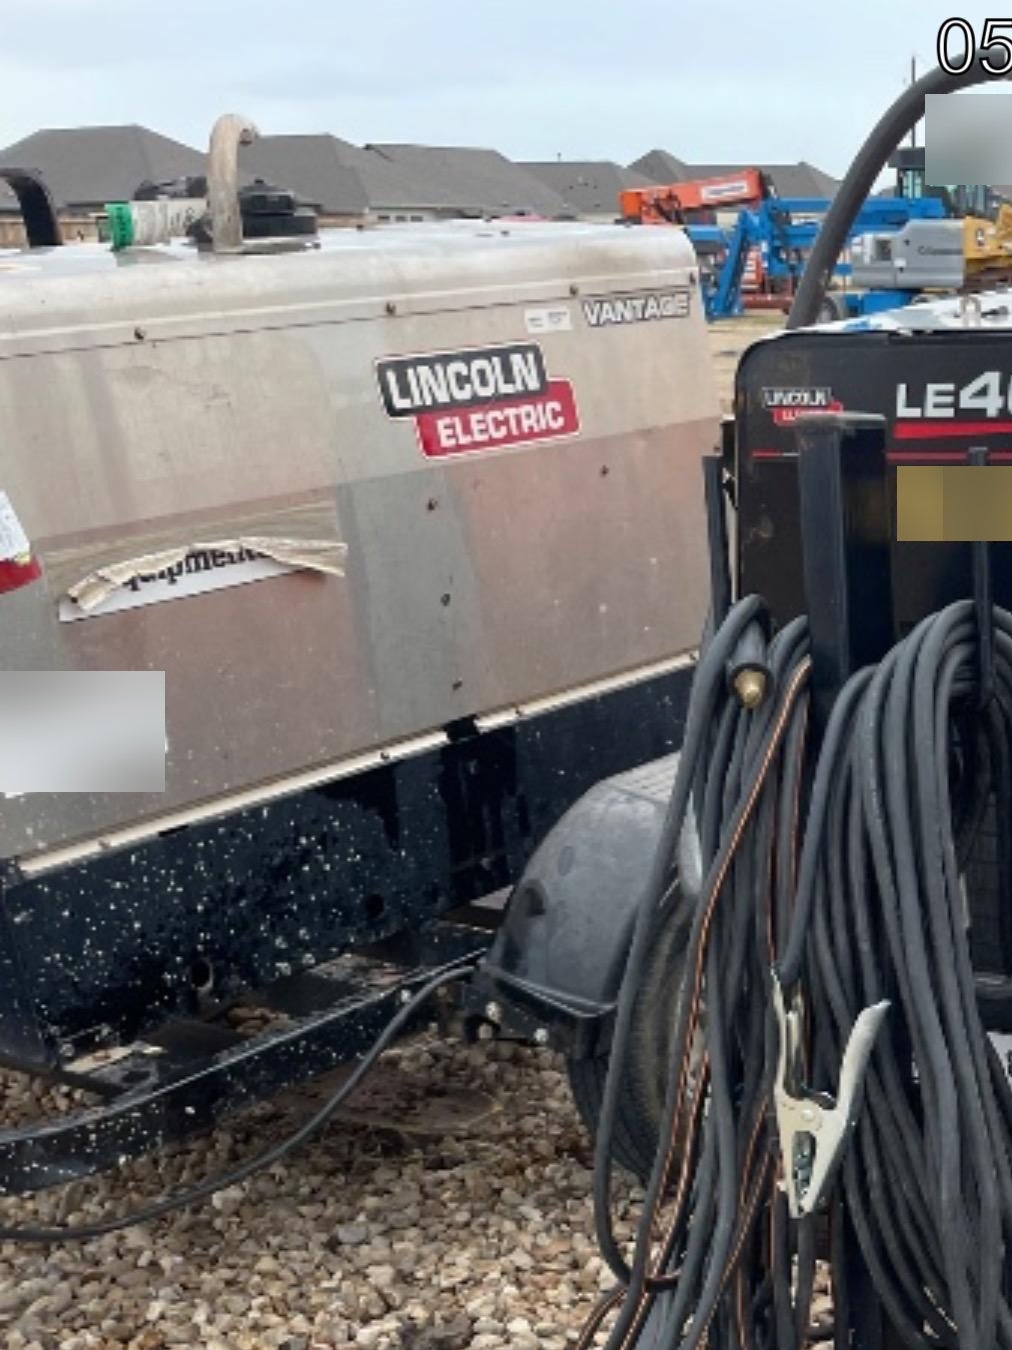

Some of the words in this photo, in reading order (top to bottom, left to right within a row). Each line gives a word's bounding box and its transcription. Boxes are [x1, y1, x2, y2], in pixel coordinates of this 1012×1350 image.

[582, 292, 690, 327] VANTAGE
[385, 353, 541, 409] LINCOLN
[436, 401, 565, 449] ELECTRIC
